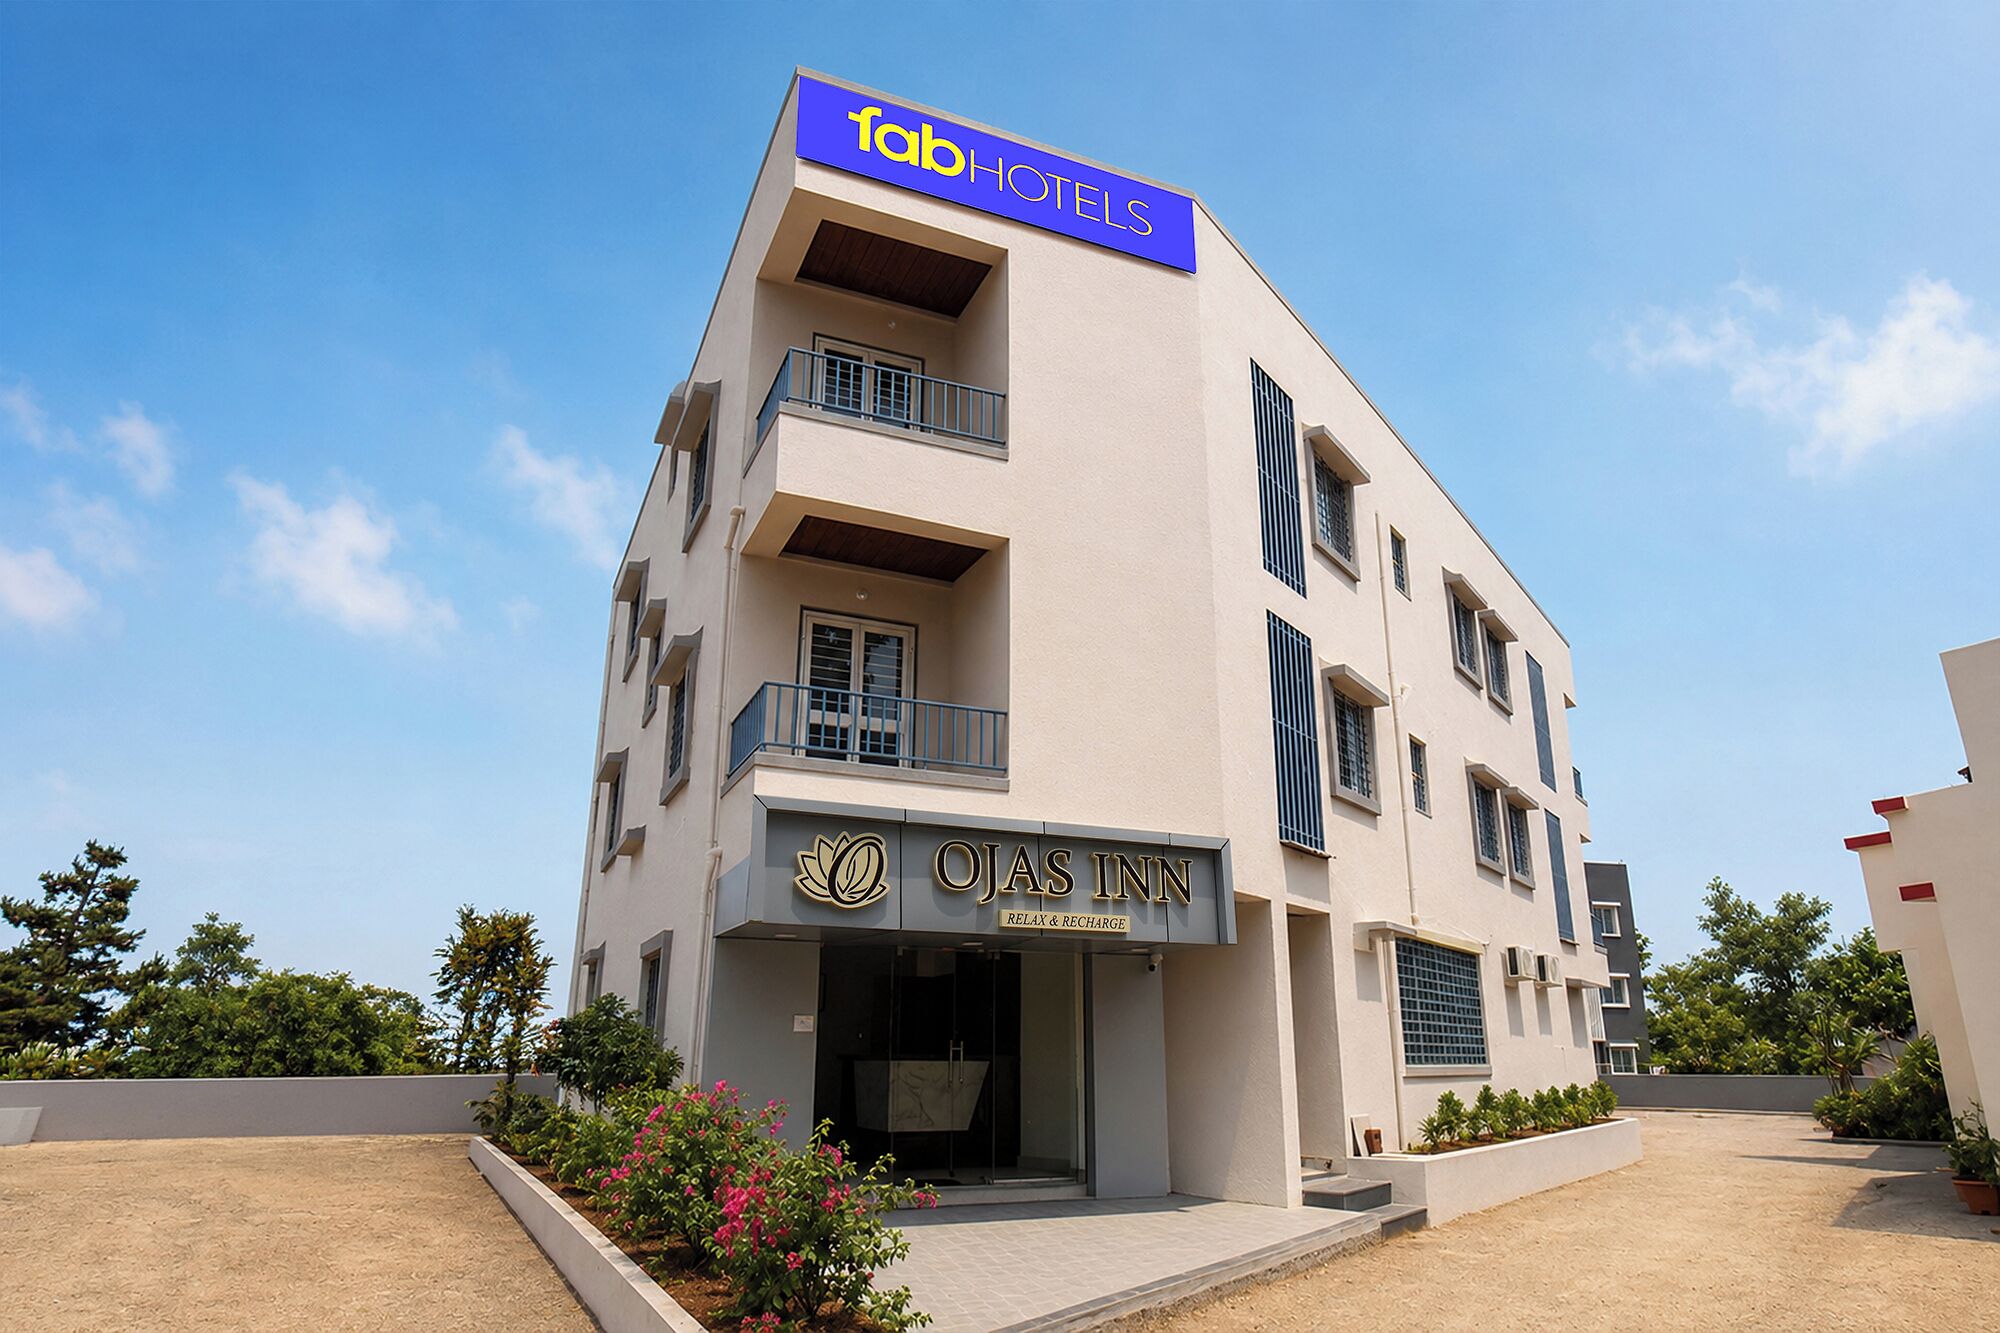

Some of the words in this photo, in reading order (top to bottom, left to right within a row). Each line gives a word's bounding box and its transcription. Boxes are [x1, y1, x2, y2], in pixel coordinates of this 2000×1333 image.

[934, 840, 1074, 905] OJAS
[1090, 852, 1194, 904] INN
[1006, 912, 1047, 926] RELAX
[1049, 914, 1059, 927] &
[1061, 914, 1126, 930] RECHARGE
